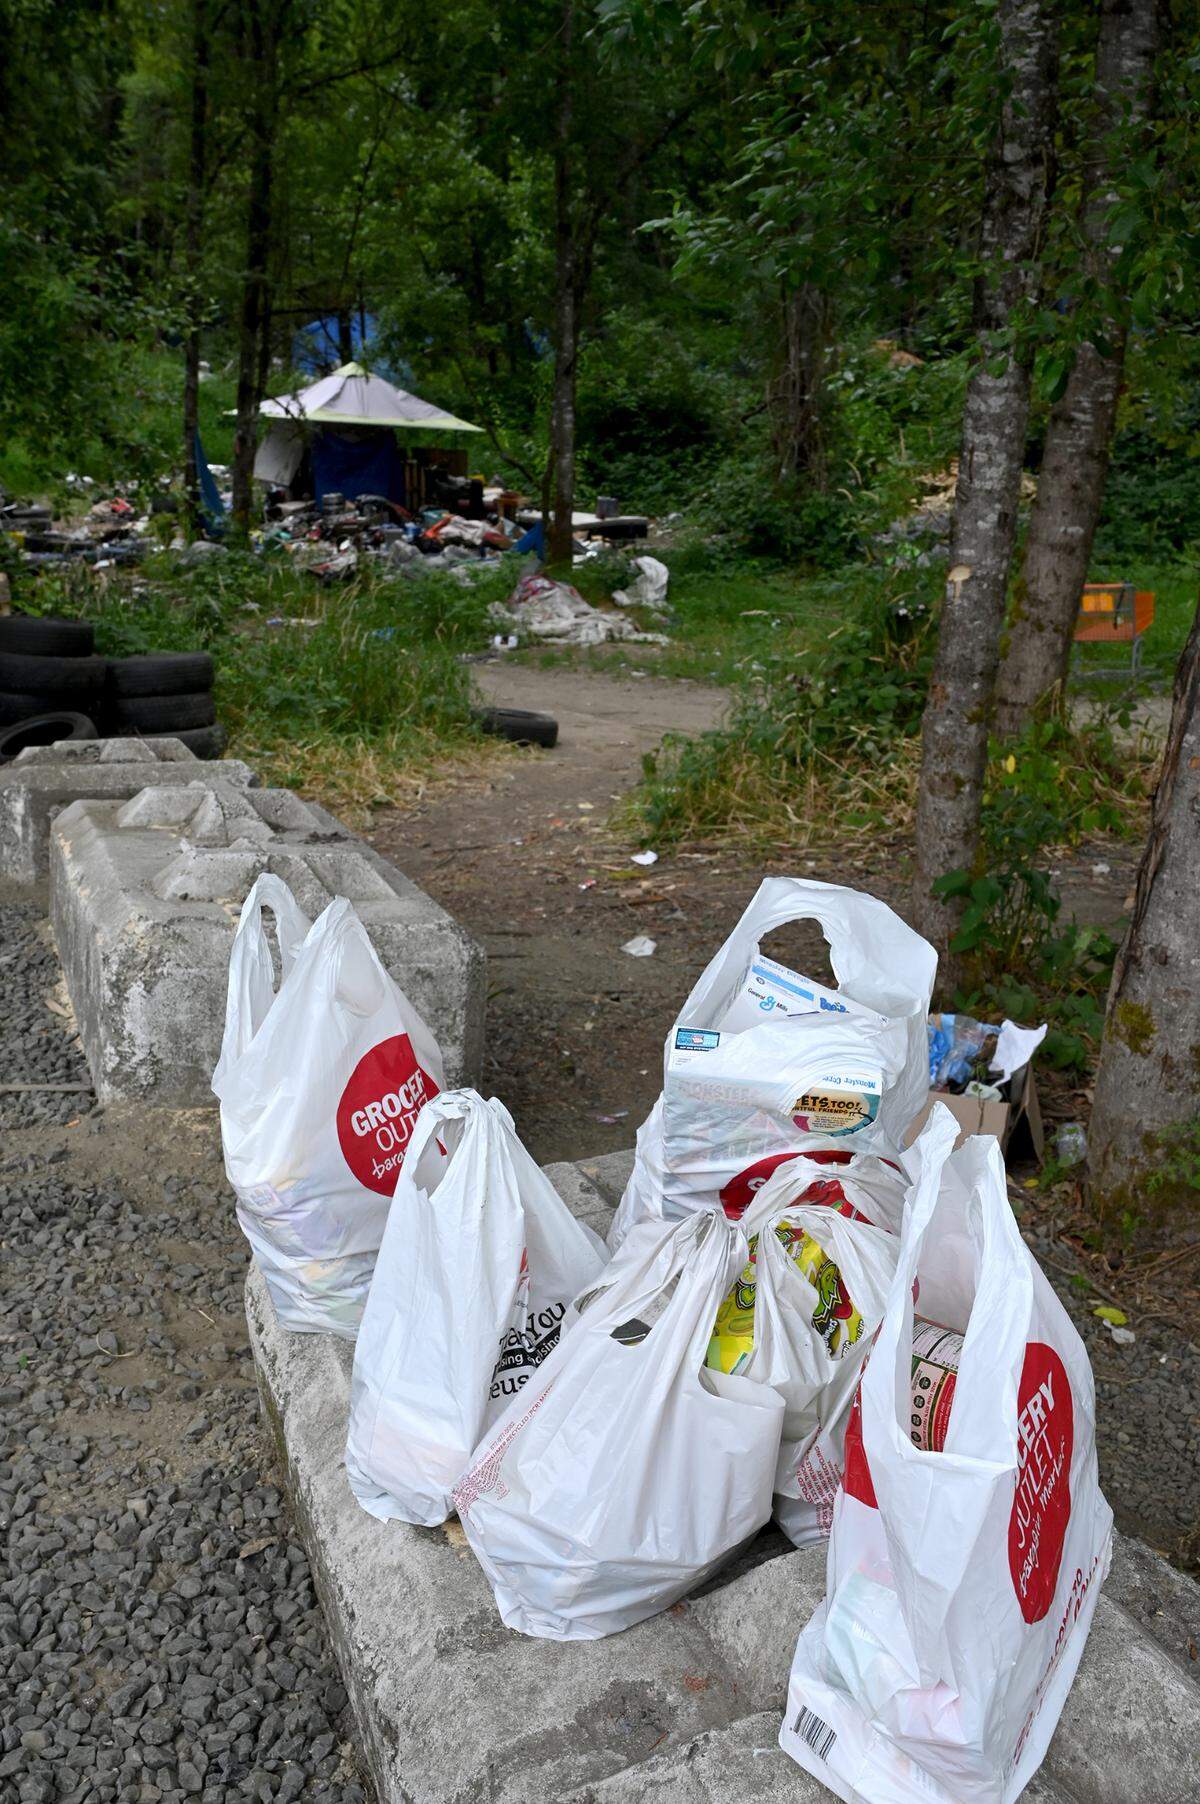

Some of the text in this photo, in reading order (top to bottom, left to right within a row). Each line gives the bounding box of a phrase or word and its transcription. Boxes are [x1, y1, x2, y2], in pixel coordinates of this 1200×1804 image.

[748, 987, 766, 1000] General
[776, 1003, 789, 1012] Mills
[351, 1068, 425, 1137] GROCER
[818, 1107, 848, 1115] FRIENDS
[830, 1100, 861, 1111] TOO!
[526, 1302, 566, 1341] You
